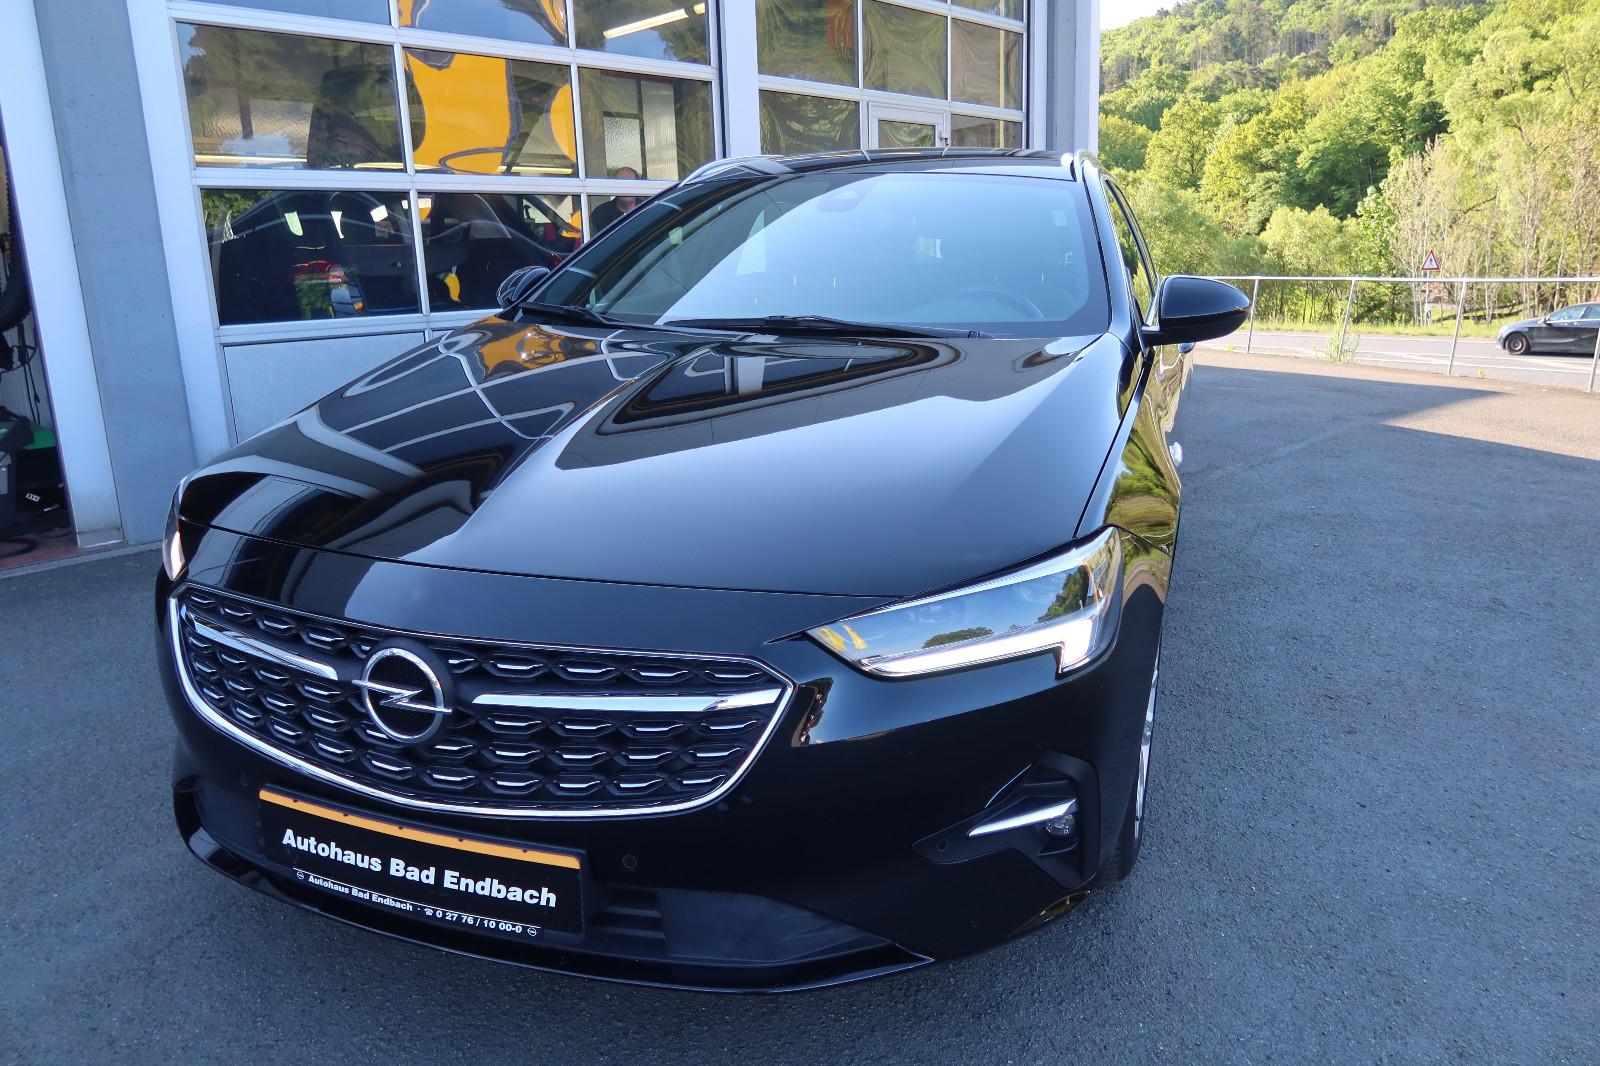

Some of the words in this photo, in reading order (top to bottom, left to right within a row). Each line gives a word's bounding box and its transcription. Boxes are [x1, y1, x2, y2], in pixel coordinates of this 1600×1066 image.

[282, 828, 382, 872] Autohaus
[389, 857, 436, 885] Bad
[443, 869, 557, 908] Endbach
[308, 875, 350, 894] Autohaus
[351, 888, 370, 900] Bad
[371, 894, 413, 912] Endbach
[445, 912, 459, 921] 27
[462, 915, 474, 925] 76
[483, 919, 496, 929] 10
[498, 922, 523, 934] 00-0
